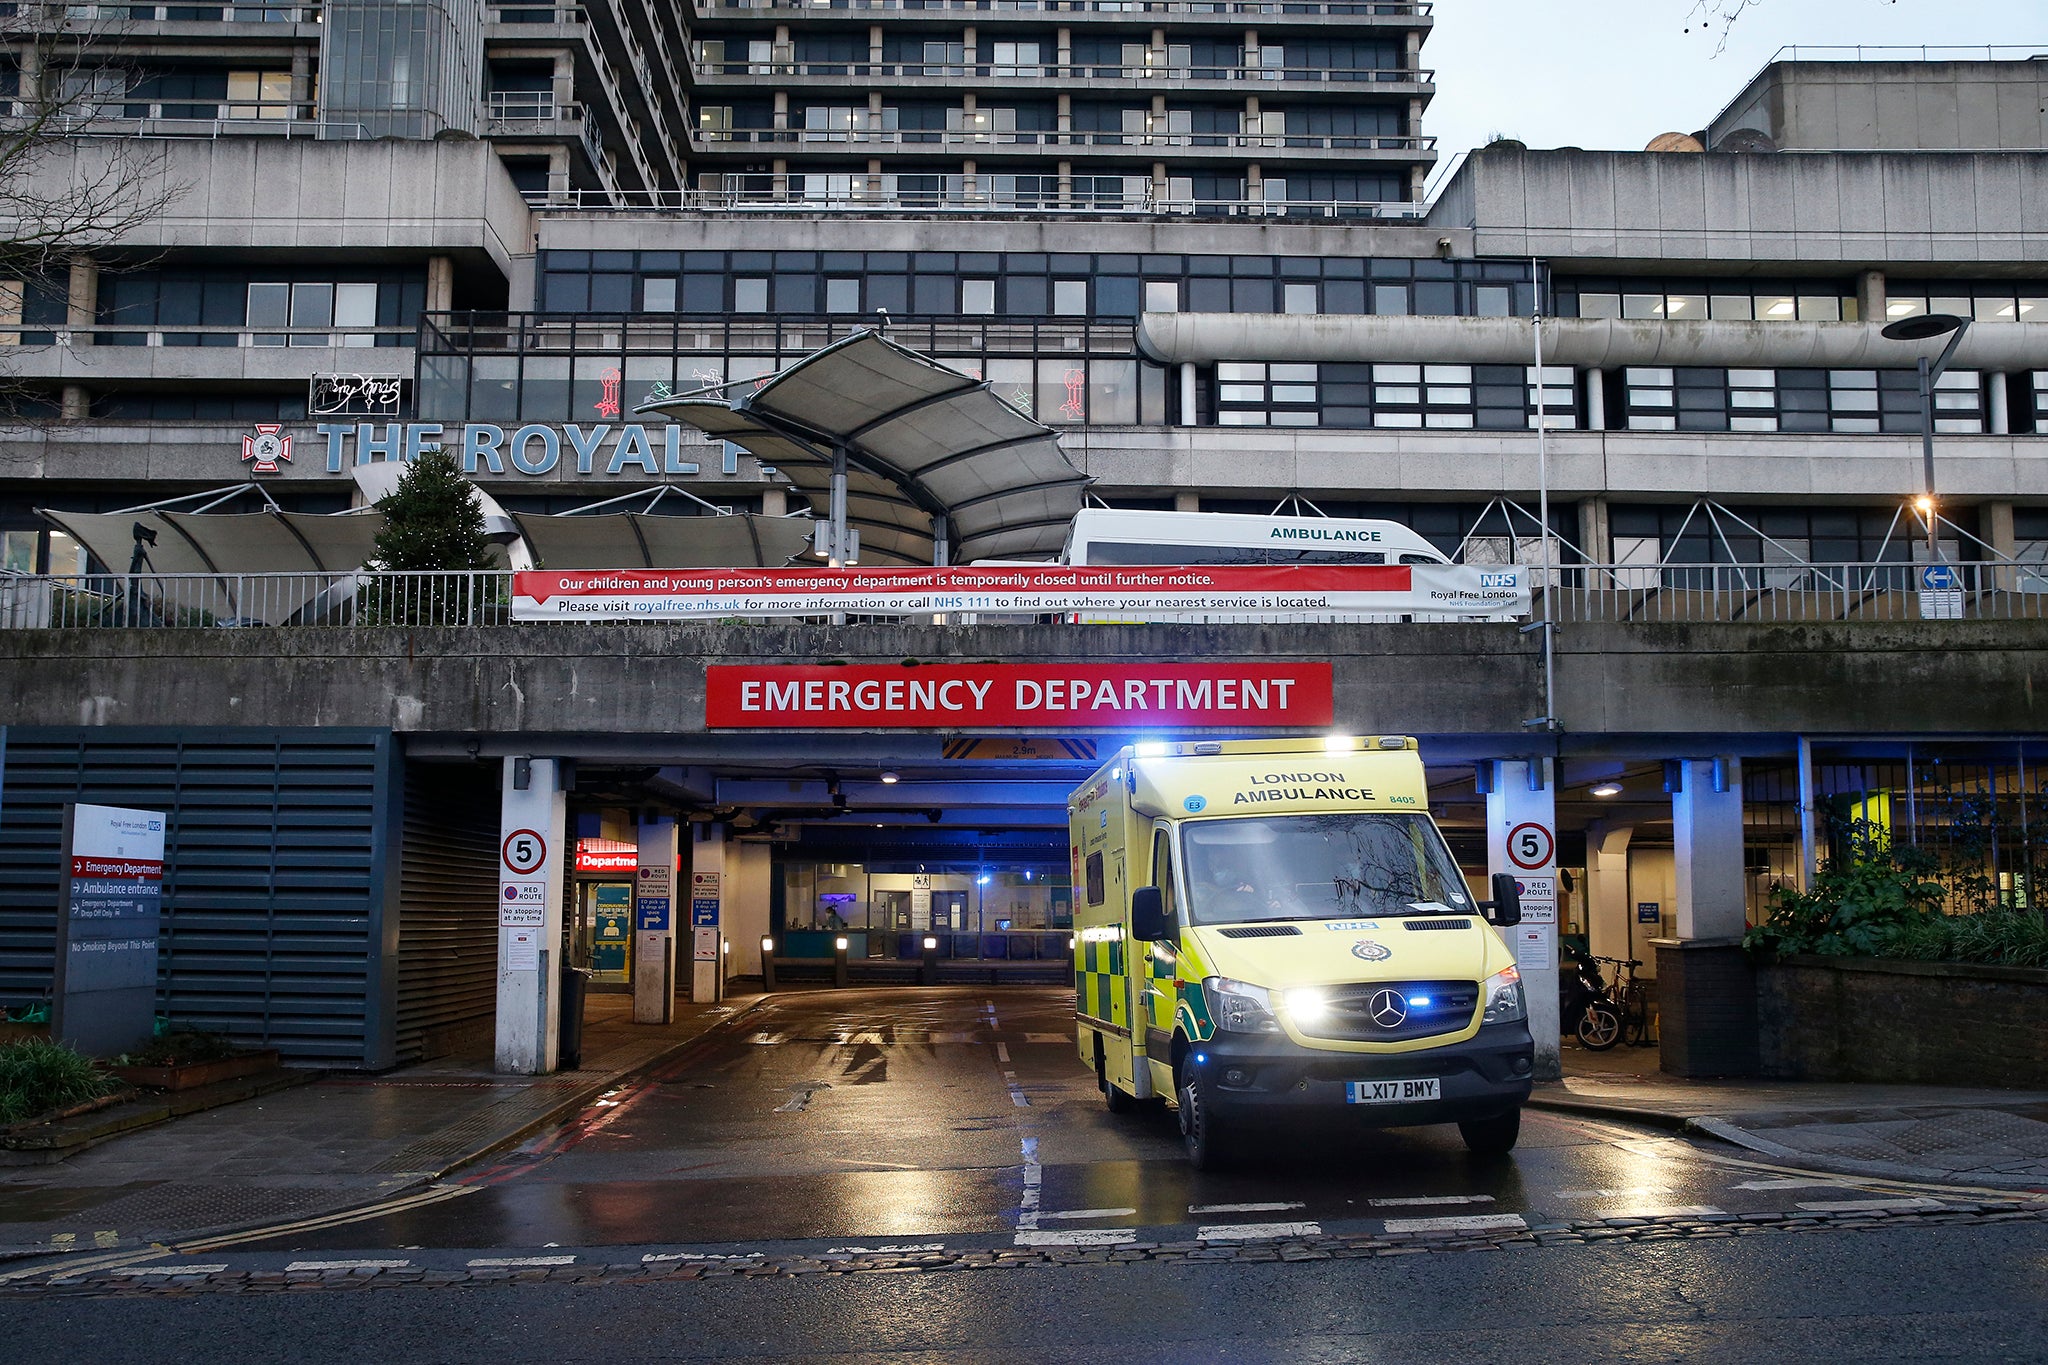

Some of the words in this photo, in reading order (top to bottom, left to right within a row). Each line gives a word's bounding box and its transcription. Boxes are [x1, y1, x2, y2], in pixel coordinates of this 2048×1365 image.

[316, 423, 444, 473] THE
[463, 423, 699, 475] ROYAL
[1270, 527, 1382, 542] AMBULANCE
[559, 578, 584, 589] Our
[587, 577, 639, 589] children
[643, 576, 668, 588] and
[672, 577, 713, 591] young
[776, 576, 849, 590] emergency
[853, 574, 932, 588] department
[936, 574, 947, 586] is
[951, 573, 1030, 588] temporarily
[1033, 573, 1076, 586] closed
[1080, 573, 1112, 586] until
[1116, 573, 1164, 585] further
[1168, 573, 1215, 585] notice.
[1482, 575, 1515, 587] NHS
[1430, 590, 1457, 600] Royal
[1459, 590, 1479, 599] Free
[1482, 590, 1518, 598] London
[558, 601, 599, 612] Please
[603, 599, 630, 611] visit
[633, 598, 739, 613] royalfree.nhs.uk
[744, 598, 765, 609] for
[768, 600, 801, 609] more
[806, 598, 885, 608] information
[890, 599, 903, 608] or
[908, 596, 930, 607] call
[934, 597, 962, 607] NHS
[968, 597, 990, 607] 111
[994, 597, 1009, 607] to
[1013, 597, 1040, 607] find
[1045, 598, 1068, 607] out
[1072, 597, 1115, 607] where
[1119, 599, 1150, 609] your
[1155, 597, 1206, 607] nearest
[1210, 597, 1257, 607] service
[1261, 597, 1272, 607] is
[1276, 597, 1330, 607] located.
[741, 680, 993, 711] EMERGENCY
[1015, 679, 1295, 711] DEPARTMENT
[1012, 746, 1036, 755] 2.9m
[1250, 772, 1346, 785] LONDON
[1233, 788, 1376, 804] AMBULANCE
[1389, 795, 1416, 804] 8405
[1189, 801, 1201, 809] E3
[110, 820, 122, 829] Royal
[122, 820, 131, 828] Free
[132, 821, 147, 829] London
[148, 821, 161, 831] NHS
[516, 840, 532, 863] 5
[1521, 834, 1539, 858] 5
[582, 856, 637, 868] Departme
[86, 861, 124, 875] Emergency
[124, 863, 161, 876] Department
[83, 882, 126, 894] Ambulance
[127, 884, 159, 895] entrance
[81, 899, 106, 909] Emergency
[107, 899, 133, 908] Department
[1523, 904, 1552, 912] stopping
[81, 910, 92, 918] Drop
[93, 909, 101, 917] Off
[102, 910, 113, 918] Only
[1327, 922, 1377, 931] NHS
[72, 943, 80, 952] No
[82, 942, 106, 952] Smoking
[107, 941, 128, 952] Beyond
[130, 940, 141, 949] This
[141, 940, 155, 949] Point
[1361, 1083, 1398, 1100] LX17
[1403, 1081, 1434, 1098] BMY
